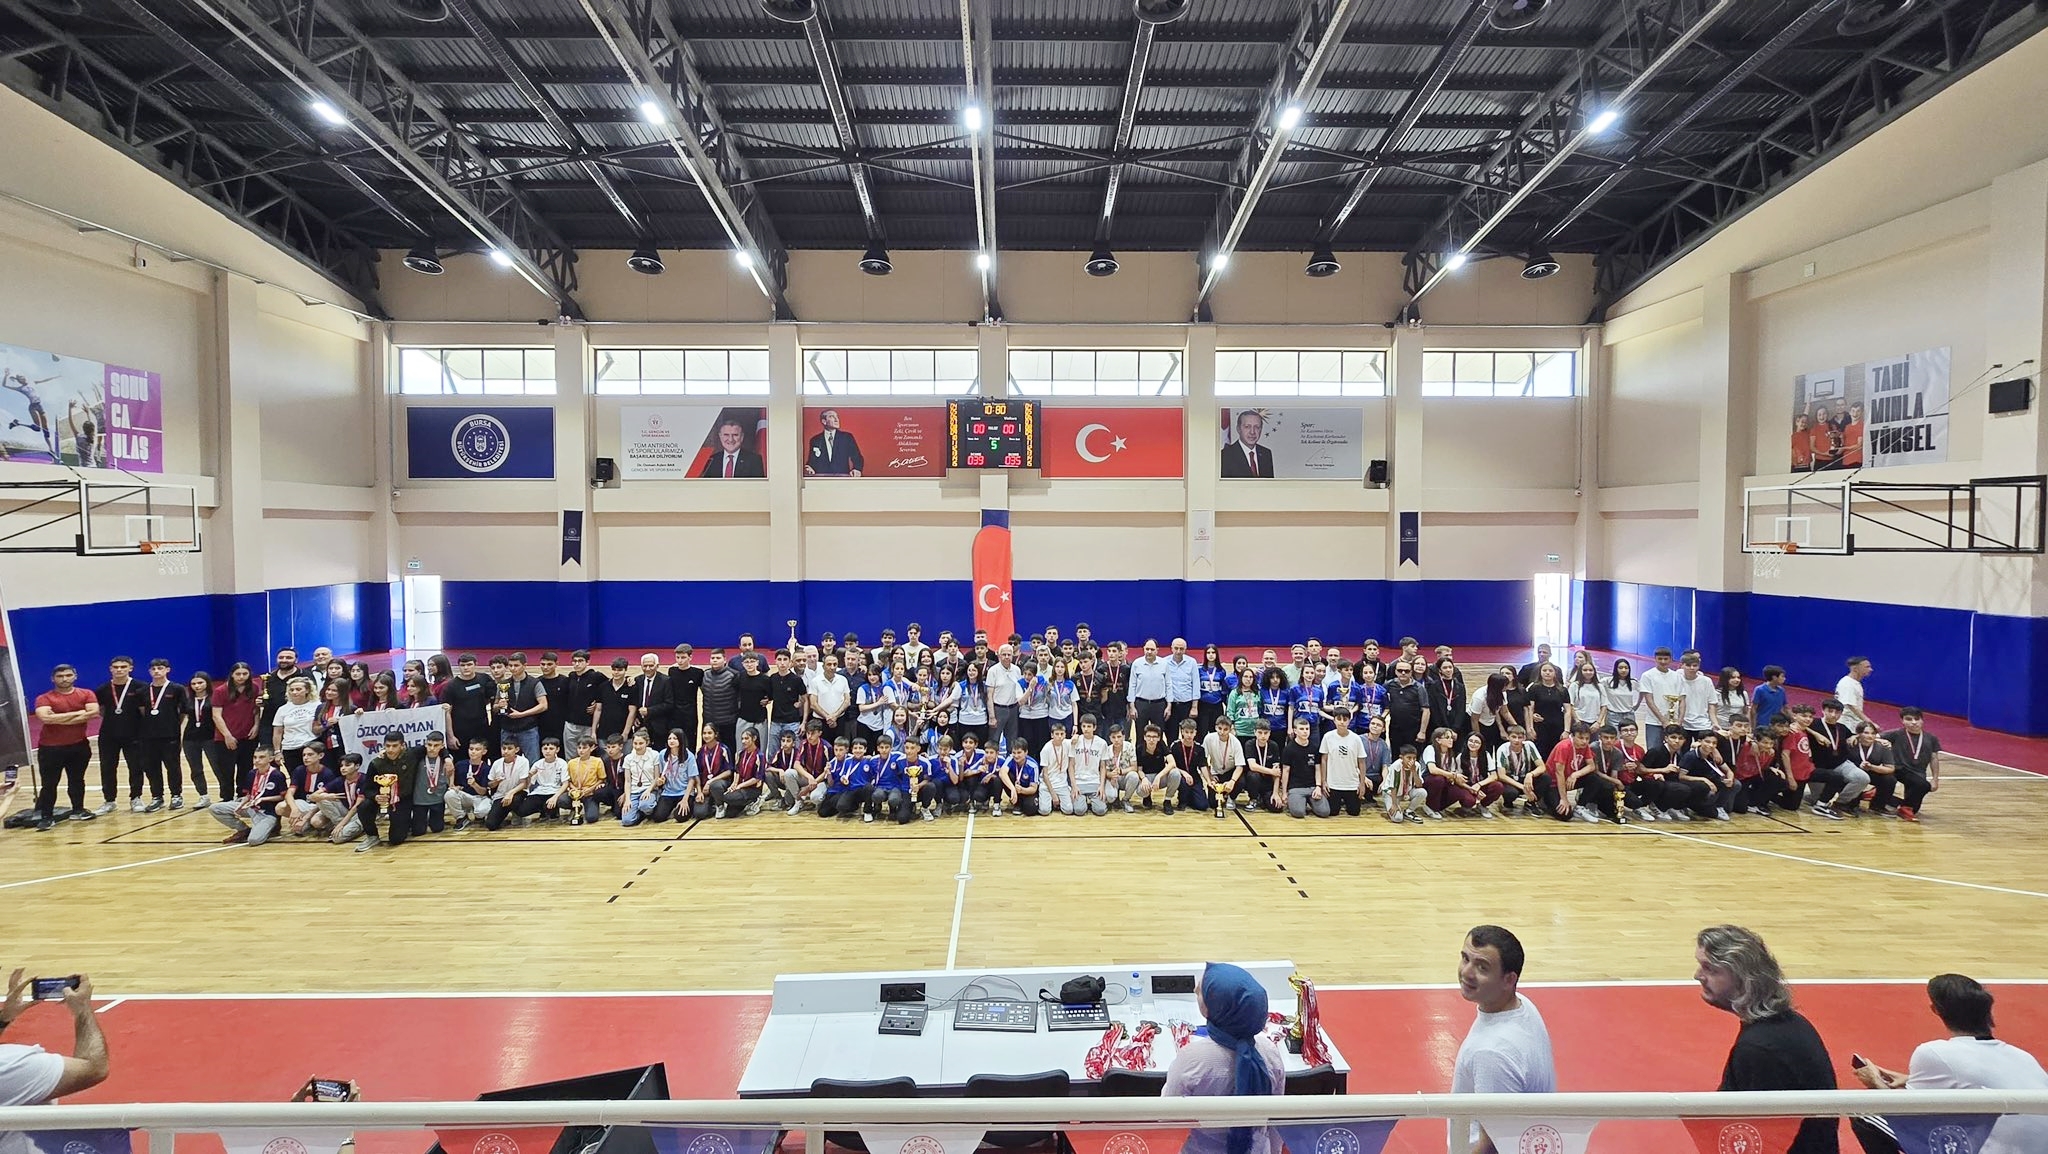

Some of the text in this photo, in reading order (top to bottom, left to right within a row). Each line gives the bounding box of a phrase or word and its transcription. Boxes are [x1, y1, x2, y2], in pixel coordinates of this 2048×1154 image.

[112, 402, 130, 429] CA
[112, 433, 149, 463] ULAŞ
[1870, 423, 1936, 455] YÜKSEL
[357, 720, 434, 738] ÖZKOCAMAN
